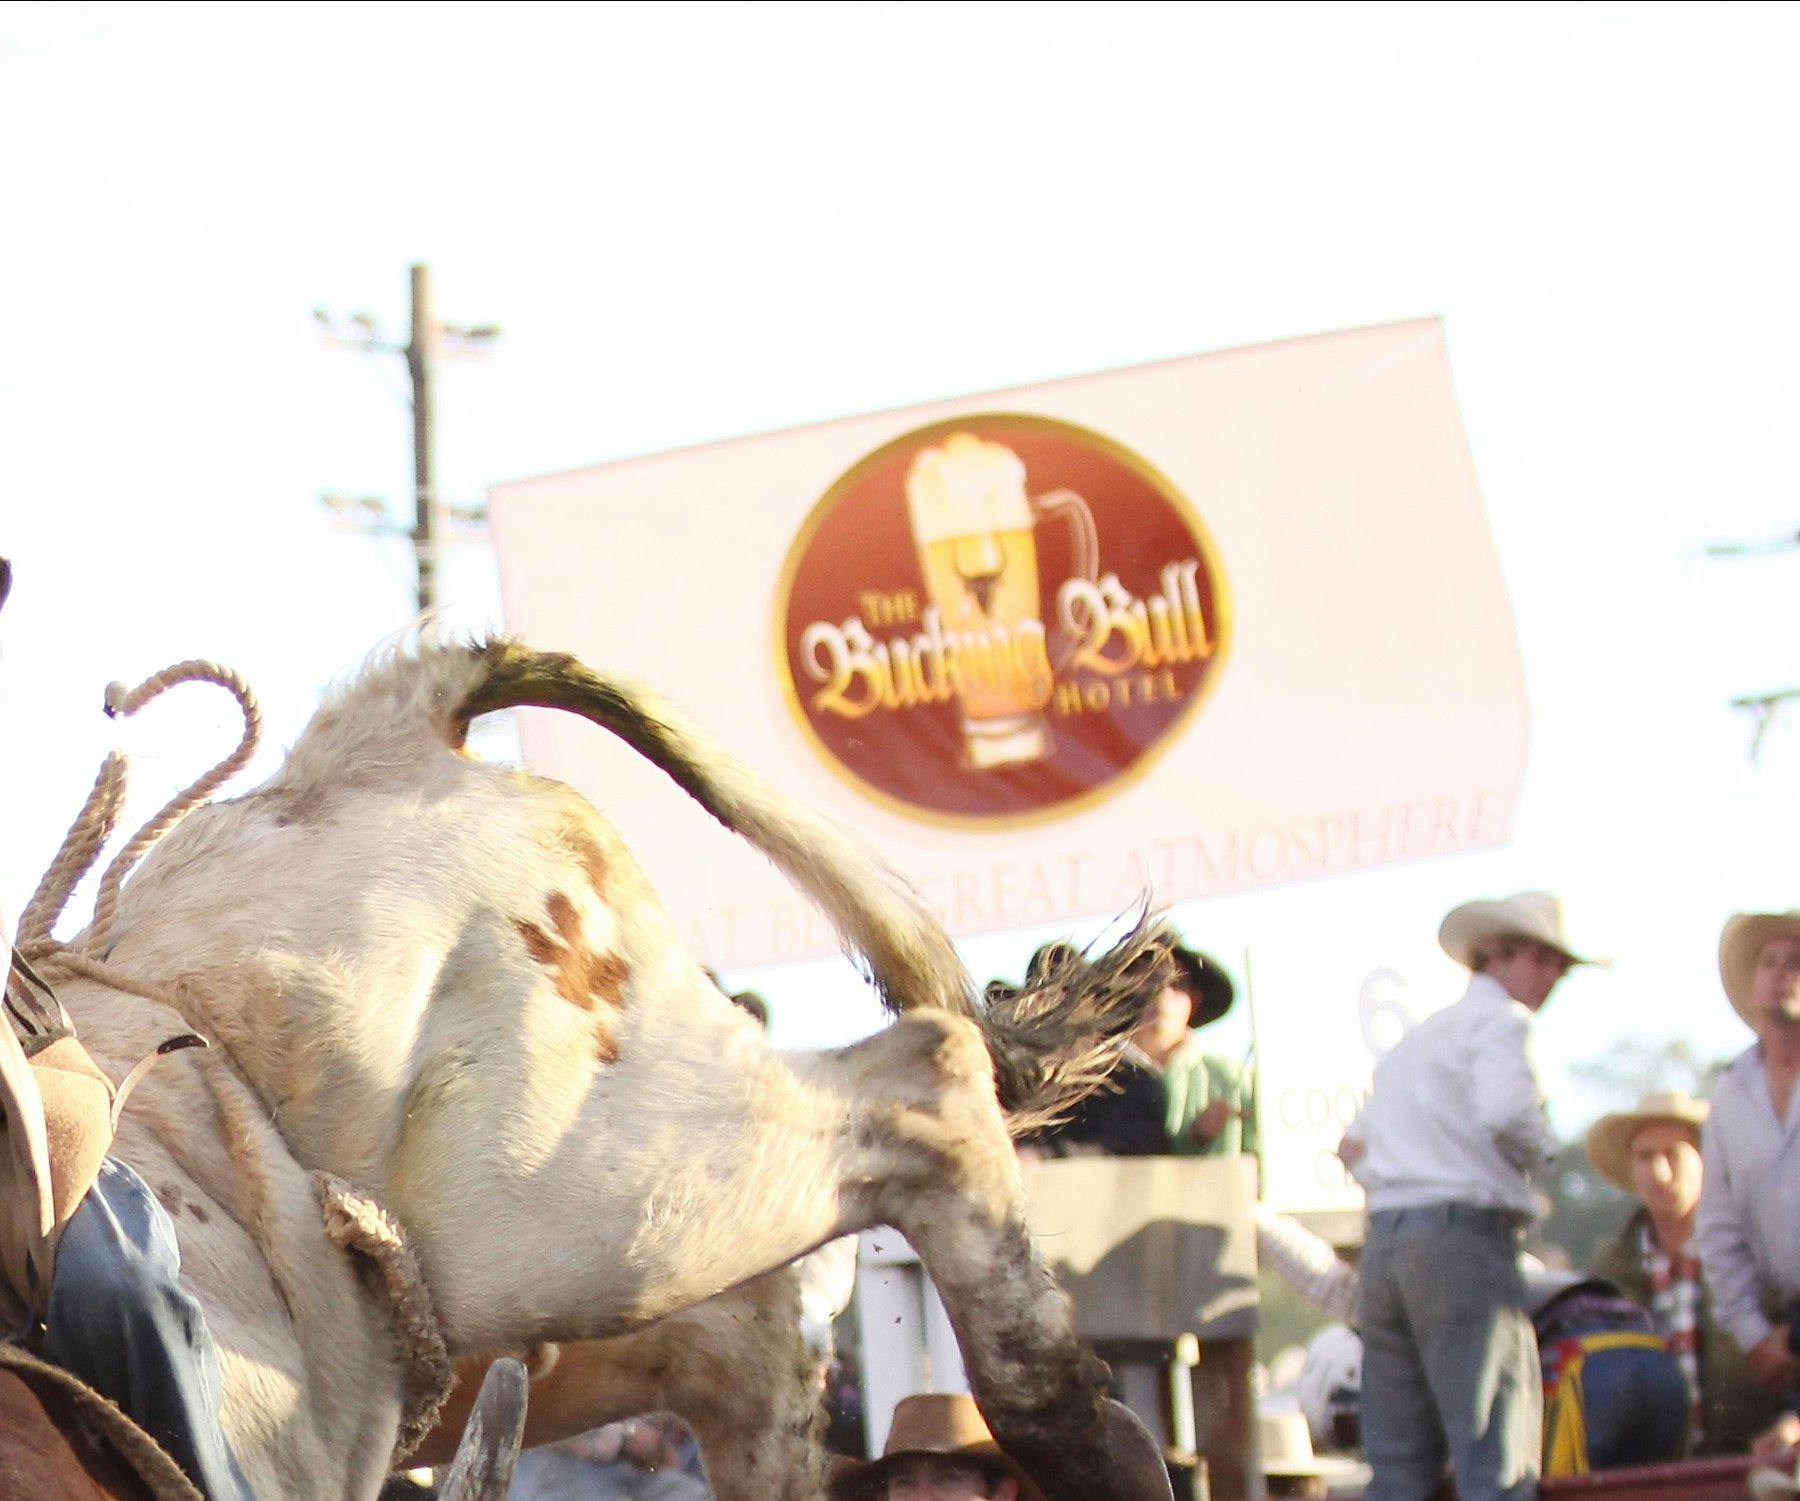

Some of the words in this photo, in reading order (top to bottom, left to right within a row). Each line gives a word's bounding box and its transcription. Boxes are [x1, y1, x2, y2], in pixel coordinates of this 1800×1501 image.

[802, 605, 1053, 720] Bucking
[1059, 559, 1216, 674] Bull
[860, 590, 917, 625] THE
[1053, 669, 1179, 715] HOTEL
[1119, 789, 1499, 893] ATMOSPHERE
